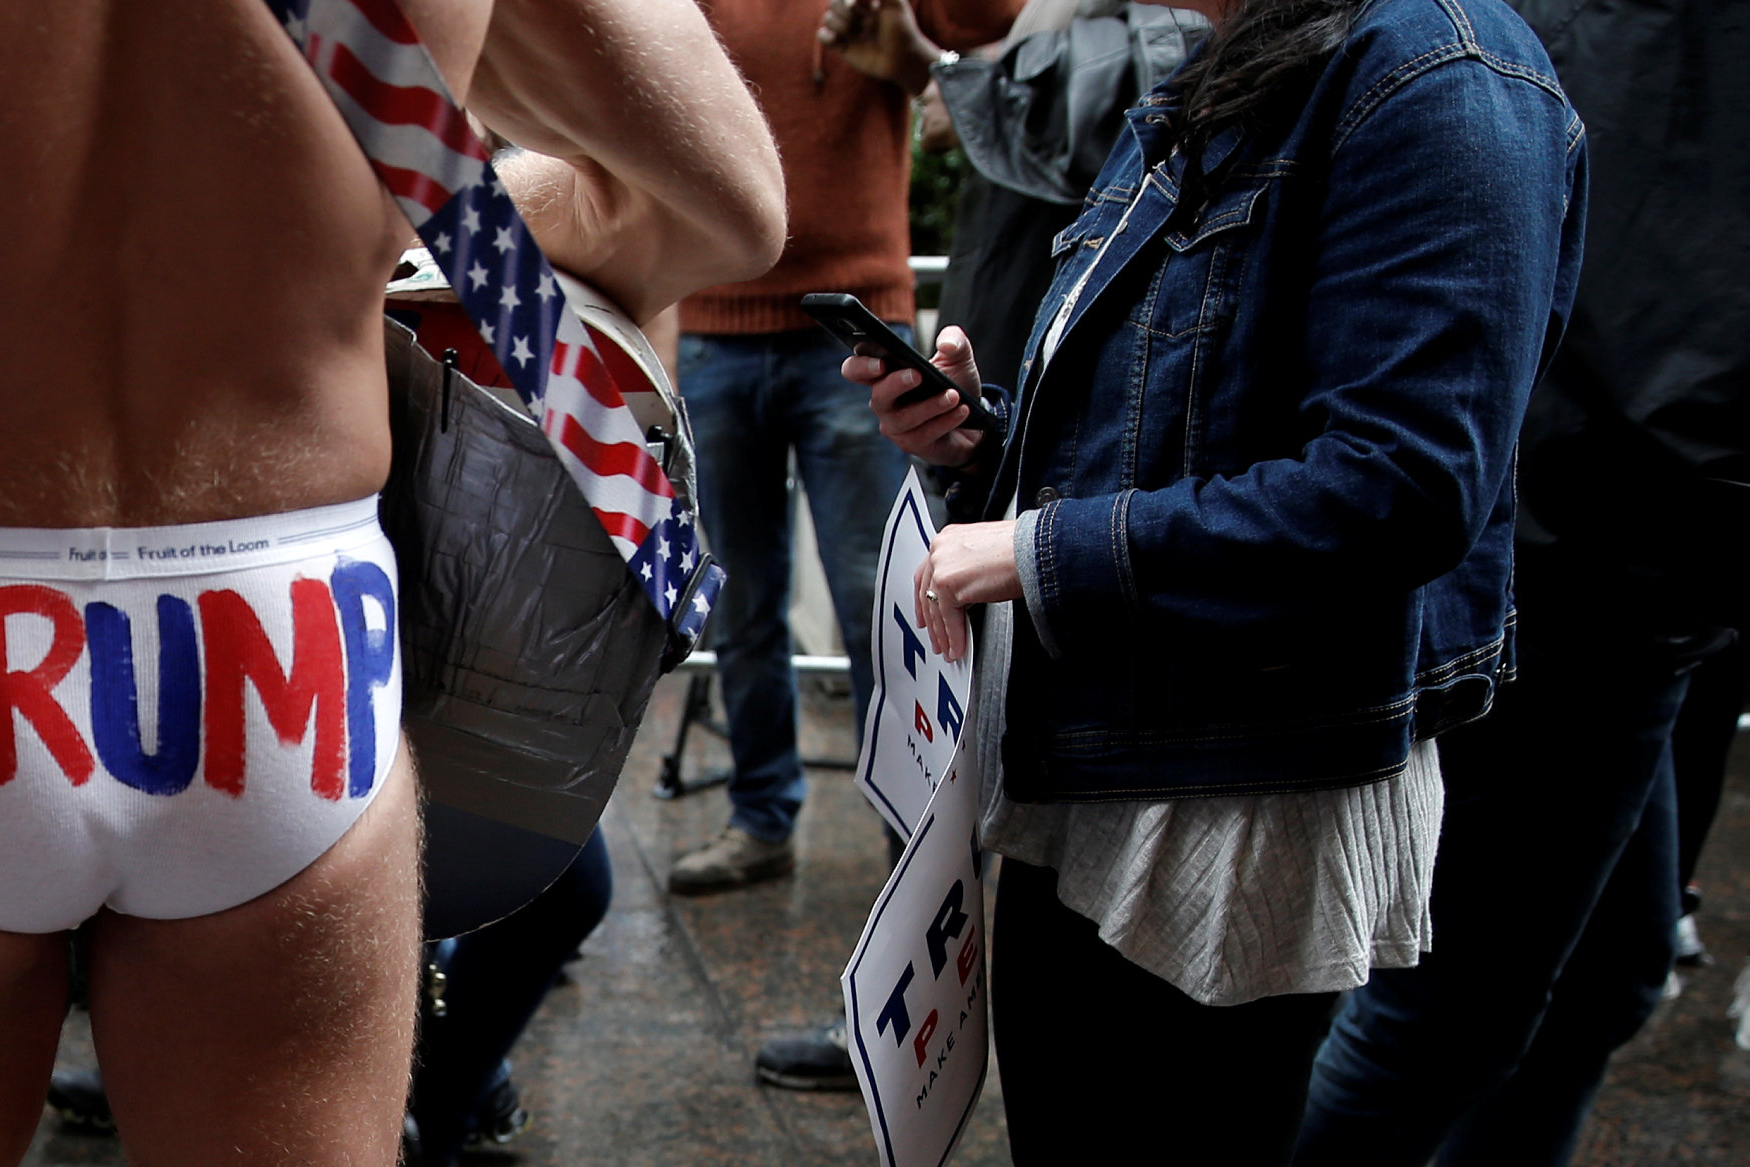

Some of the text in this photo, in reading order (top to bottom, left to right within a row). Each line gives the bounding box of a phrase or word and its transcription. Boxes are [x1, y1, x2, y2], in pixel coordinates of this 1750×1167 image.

[138, 539, 270, 560] Fruit of the Loom
[916, 1031, 956, 1110] MAKE
